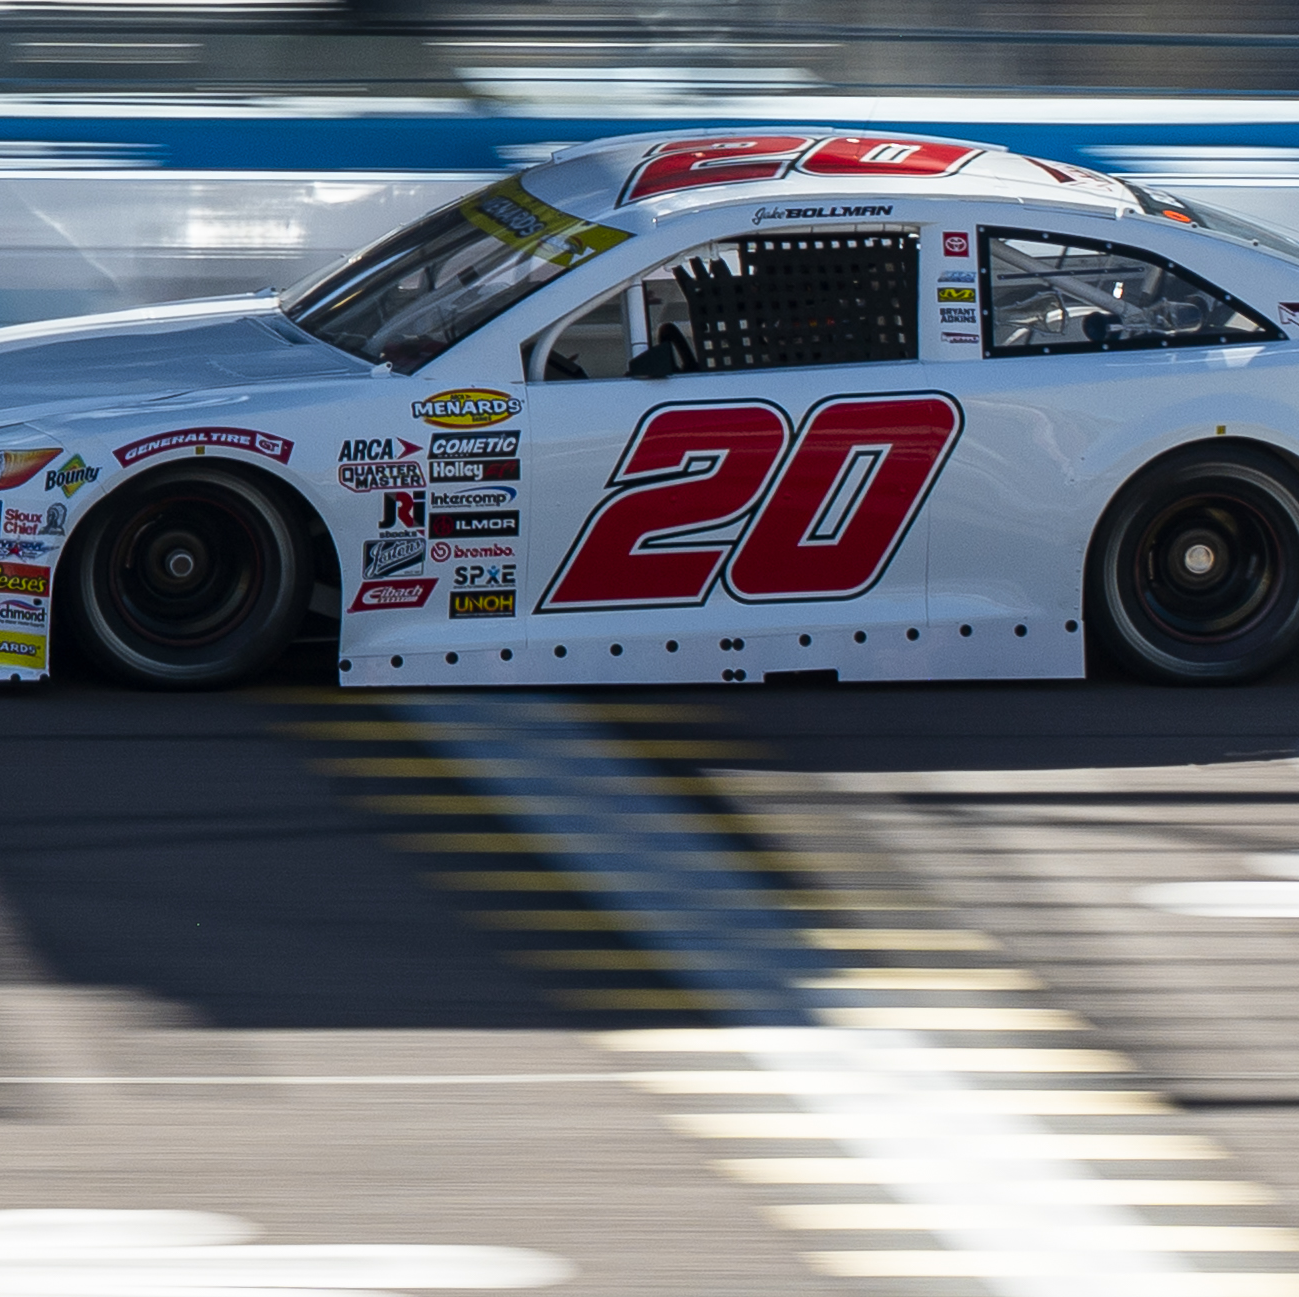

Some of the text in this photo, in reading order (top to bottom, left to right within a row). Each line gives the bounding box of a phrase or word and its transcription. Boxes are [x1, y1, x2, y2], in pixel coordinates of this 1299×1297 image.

[785, 205, 893, 219] BOLLMAN
[411, 398, 522, 418] MENARDS
[124, 433, 251, 461] GENERAL TIRE
[338, 438, 394, 462] ARCA
[432, 437, 517, 454] COMETIC
[45, 466, 102, 492] Bounty
[342, 464, 418, 483] QUARTER
[432, 461, 484, 481] Holley
[355, 475, 422, 489] MASTER
[430, 491, 507, 507] Intercomp
[531, 390, 965, 615] 20
[5, 508, 43, 524] Sioux
[455, 518, 516, 530] ILMOR
[3, 522, 39, 536] Chief
[453, 543, 513, 559] brembo
[455, 595, 513, 612] UNOH
